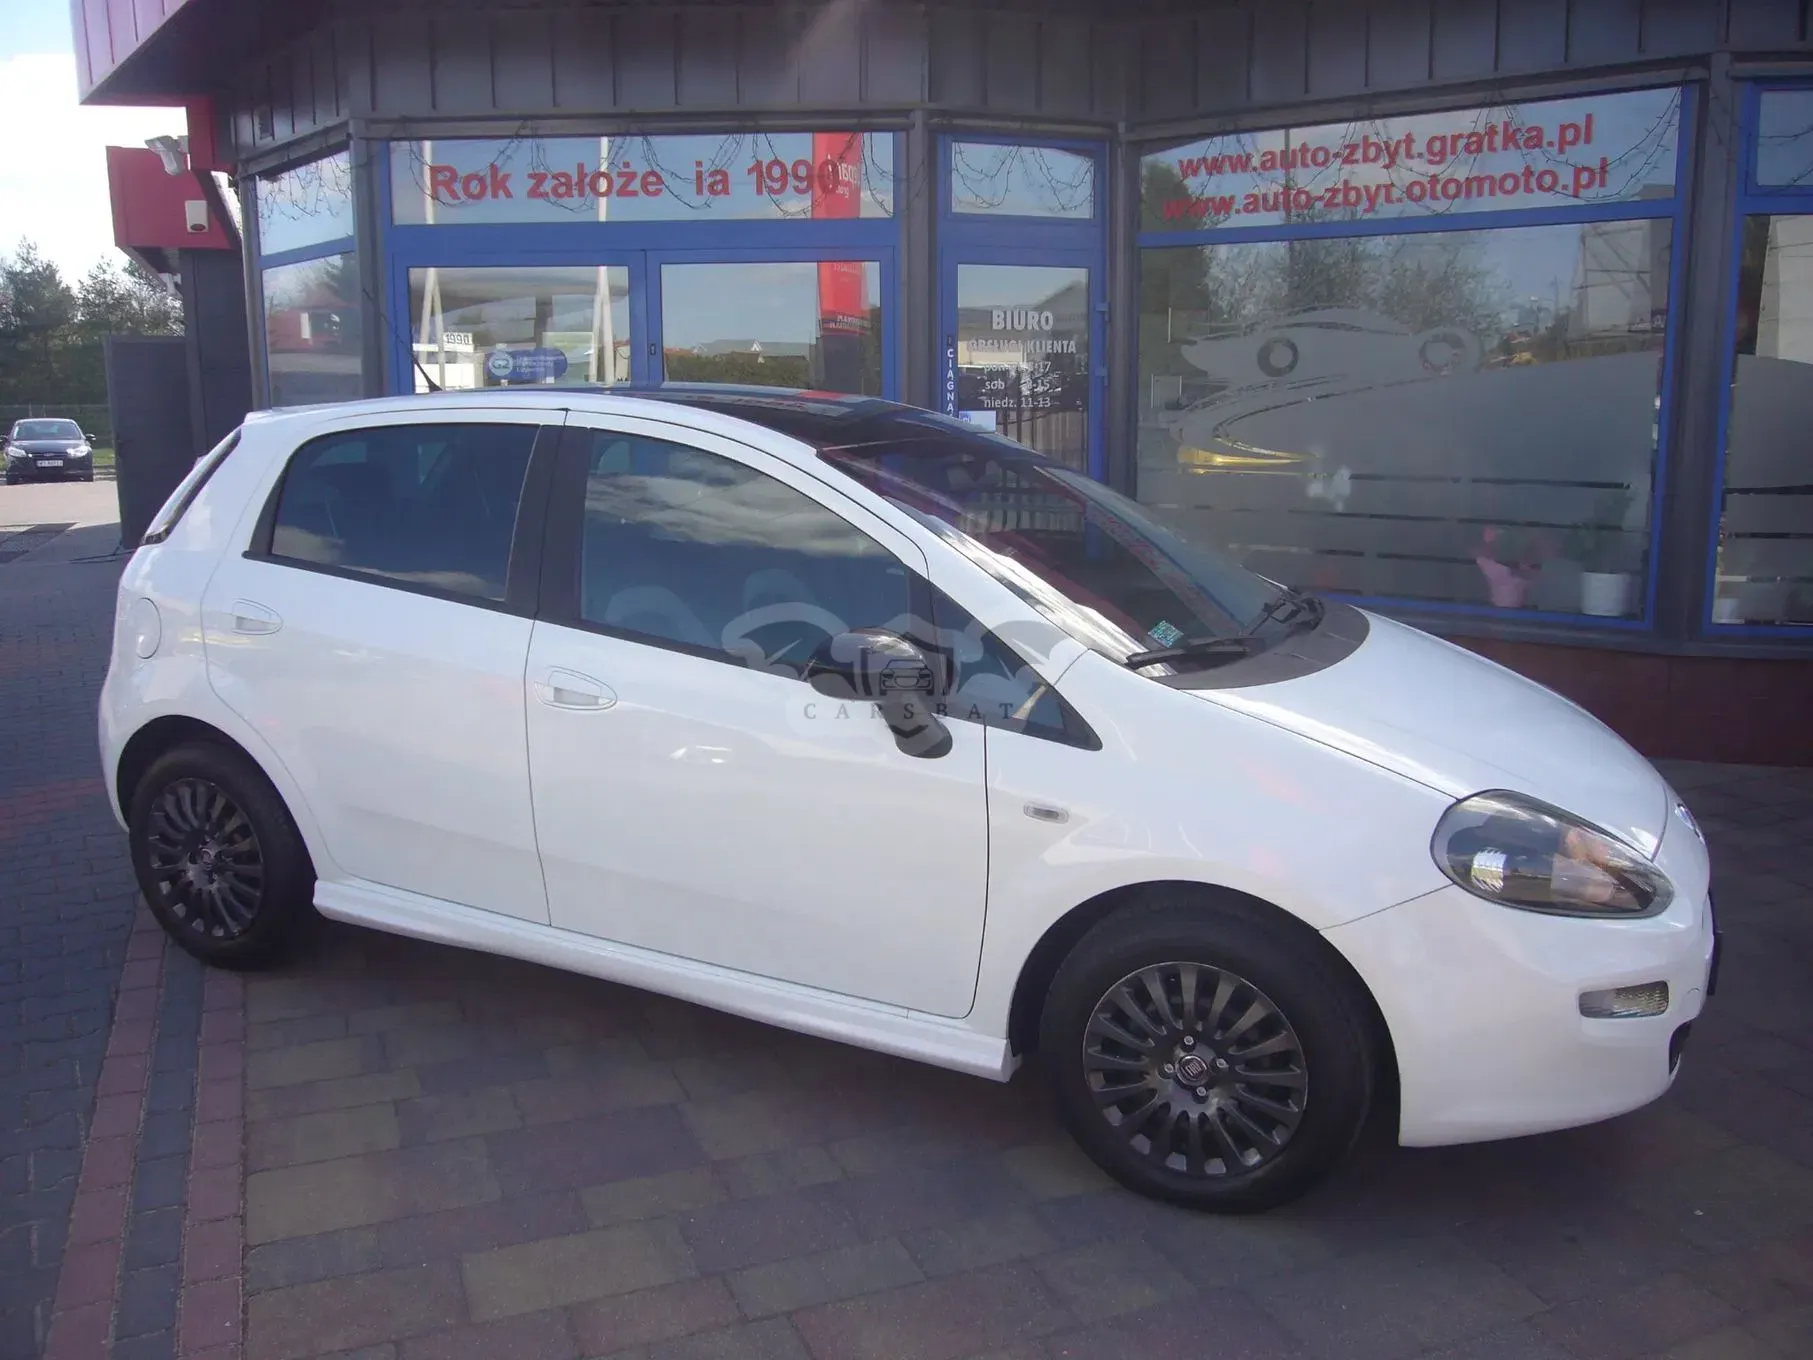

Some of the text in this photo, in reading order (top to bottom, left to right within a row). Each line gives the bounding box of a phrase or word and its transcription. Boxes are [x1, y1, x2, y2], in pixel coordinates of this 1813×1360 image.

[1178, 113, 1594, 179] www.auto-zbyt.gratka.pl
[430, 162, 514, 200] Rok
[747, 159, 839, 196] 1990
[1163, 157, 1608, 220] www.auto-zbyt.otomoto.pl
[992, 309, 1054, 331] BIURO
[1027, 339, 1077, 354] KLIENTA
[984, 378, 1006, 391] sob
[983, 396, 1018, 409] niedz.
